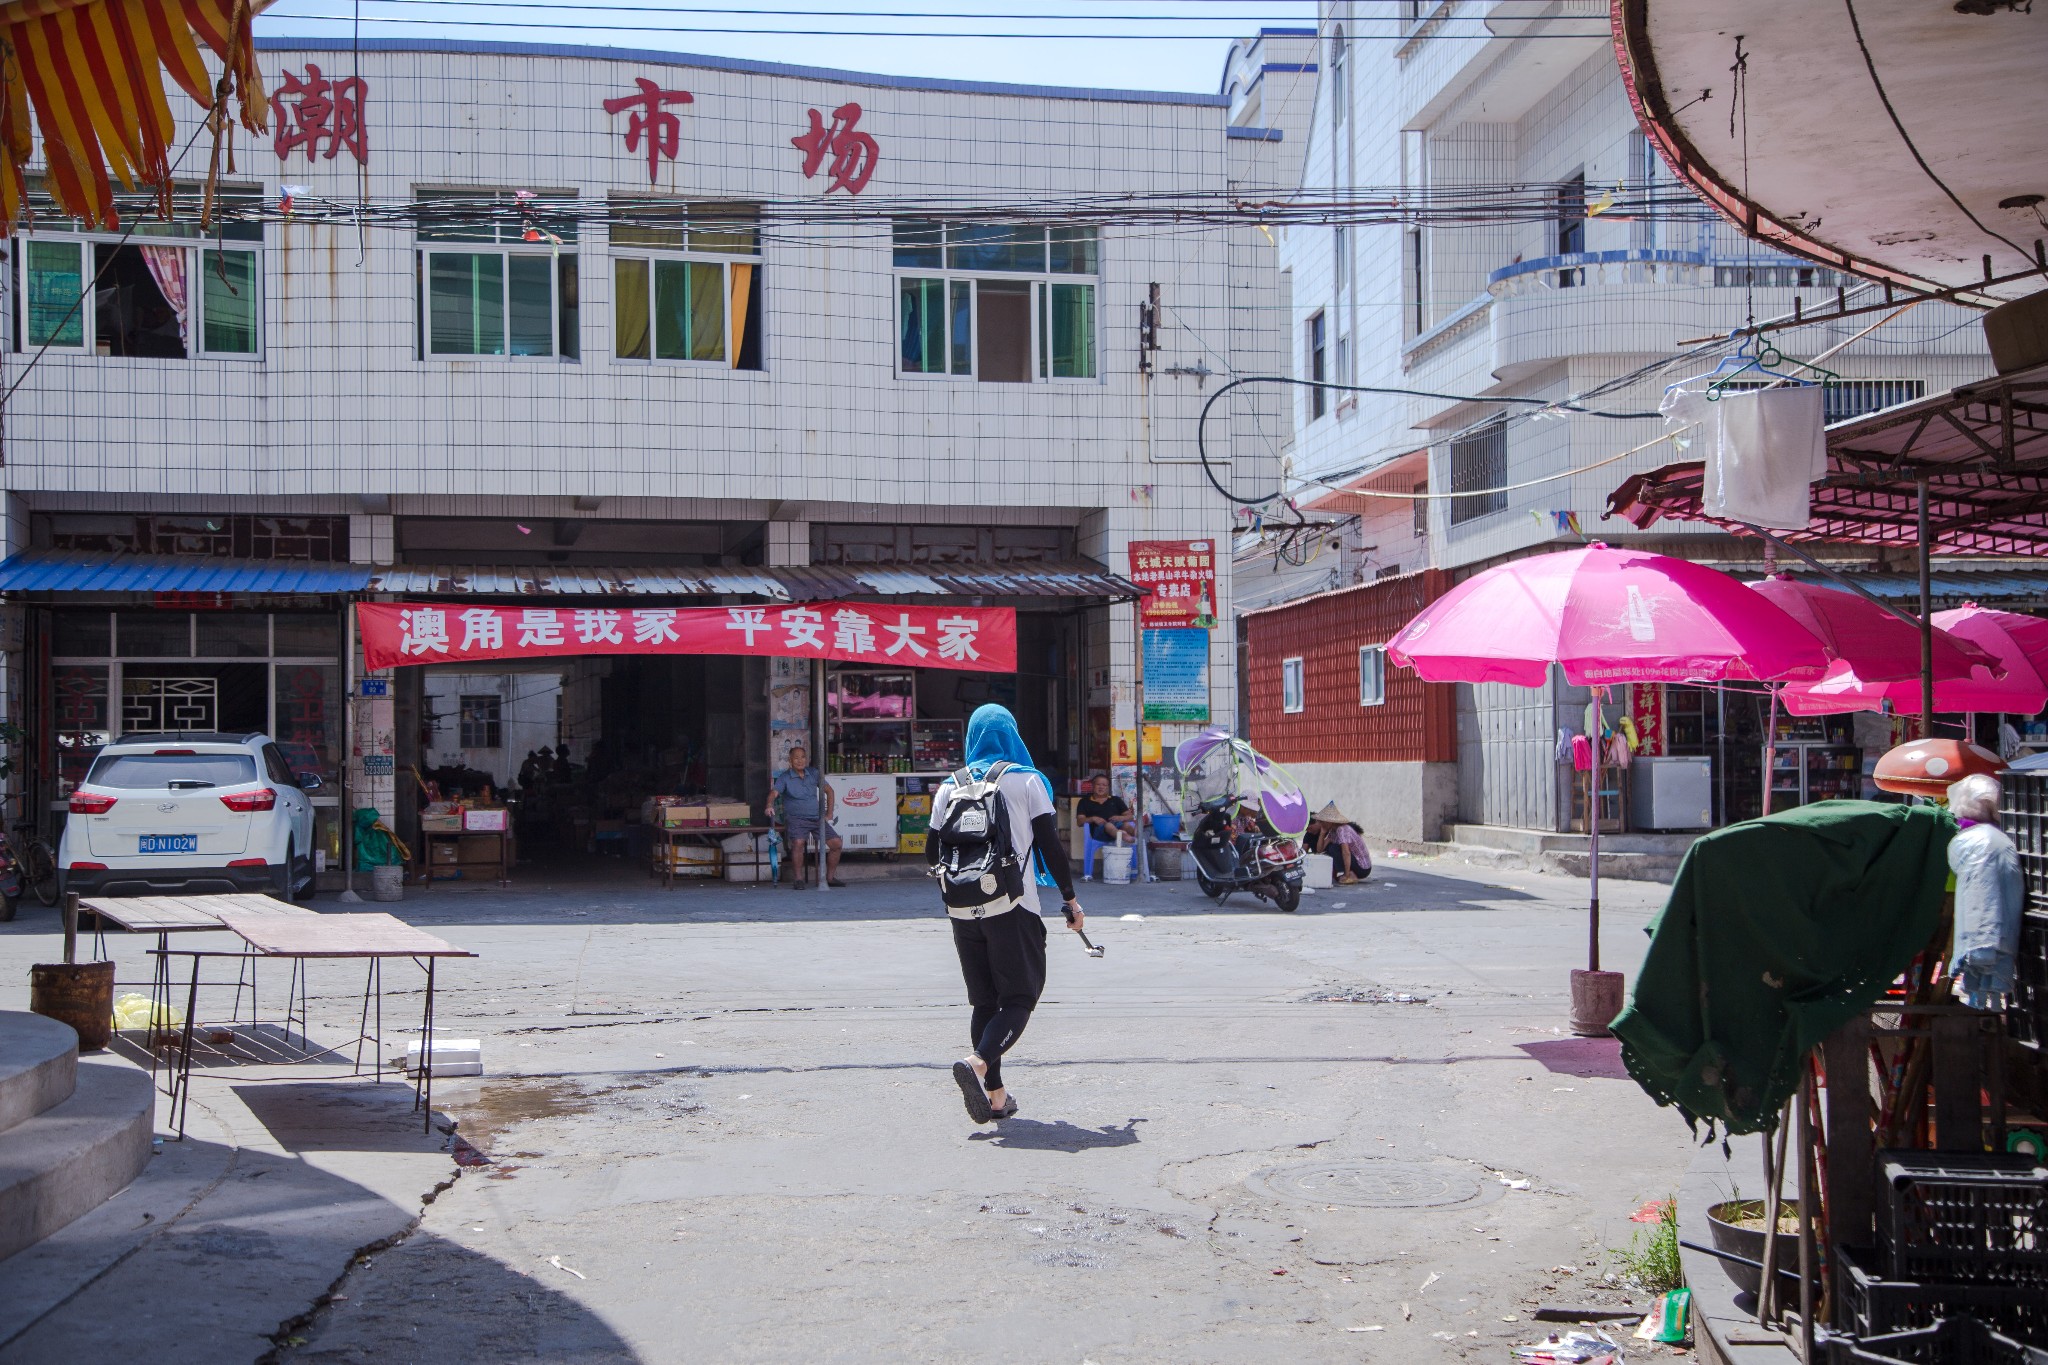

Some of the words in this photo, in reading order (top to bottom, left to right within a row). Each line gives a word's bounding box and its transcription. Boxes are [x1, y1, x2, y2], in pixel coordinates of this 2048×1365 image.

[272, 64, 369, 165] 潮
[1137, 556, 1210, 569] 长城天赋葡园
[1157, 583, 1191, 597] 专卖店
[399, 608, 680, 656] 澳角是我家
[726, 607, 980, 661] 平安靠大家
